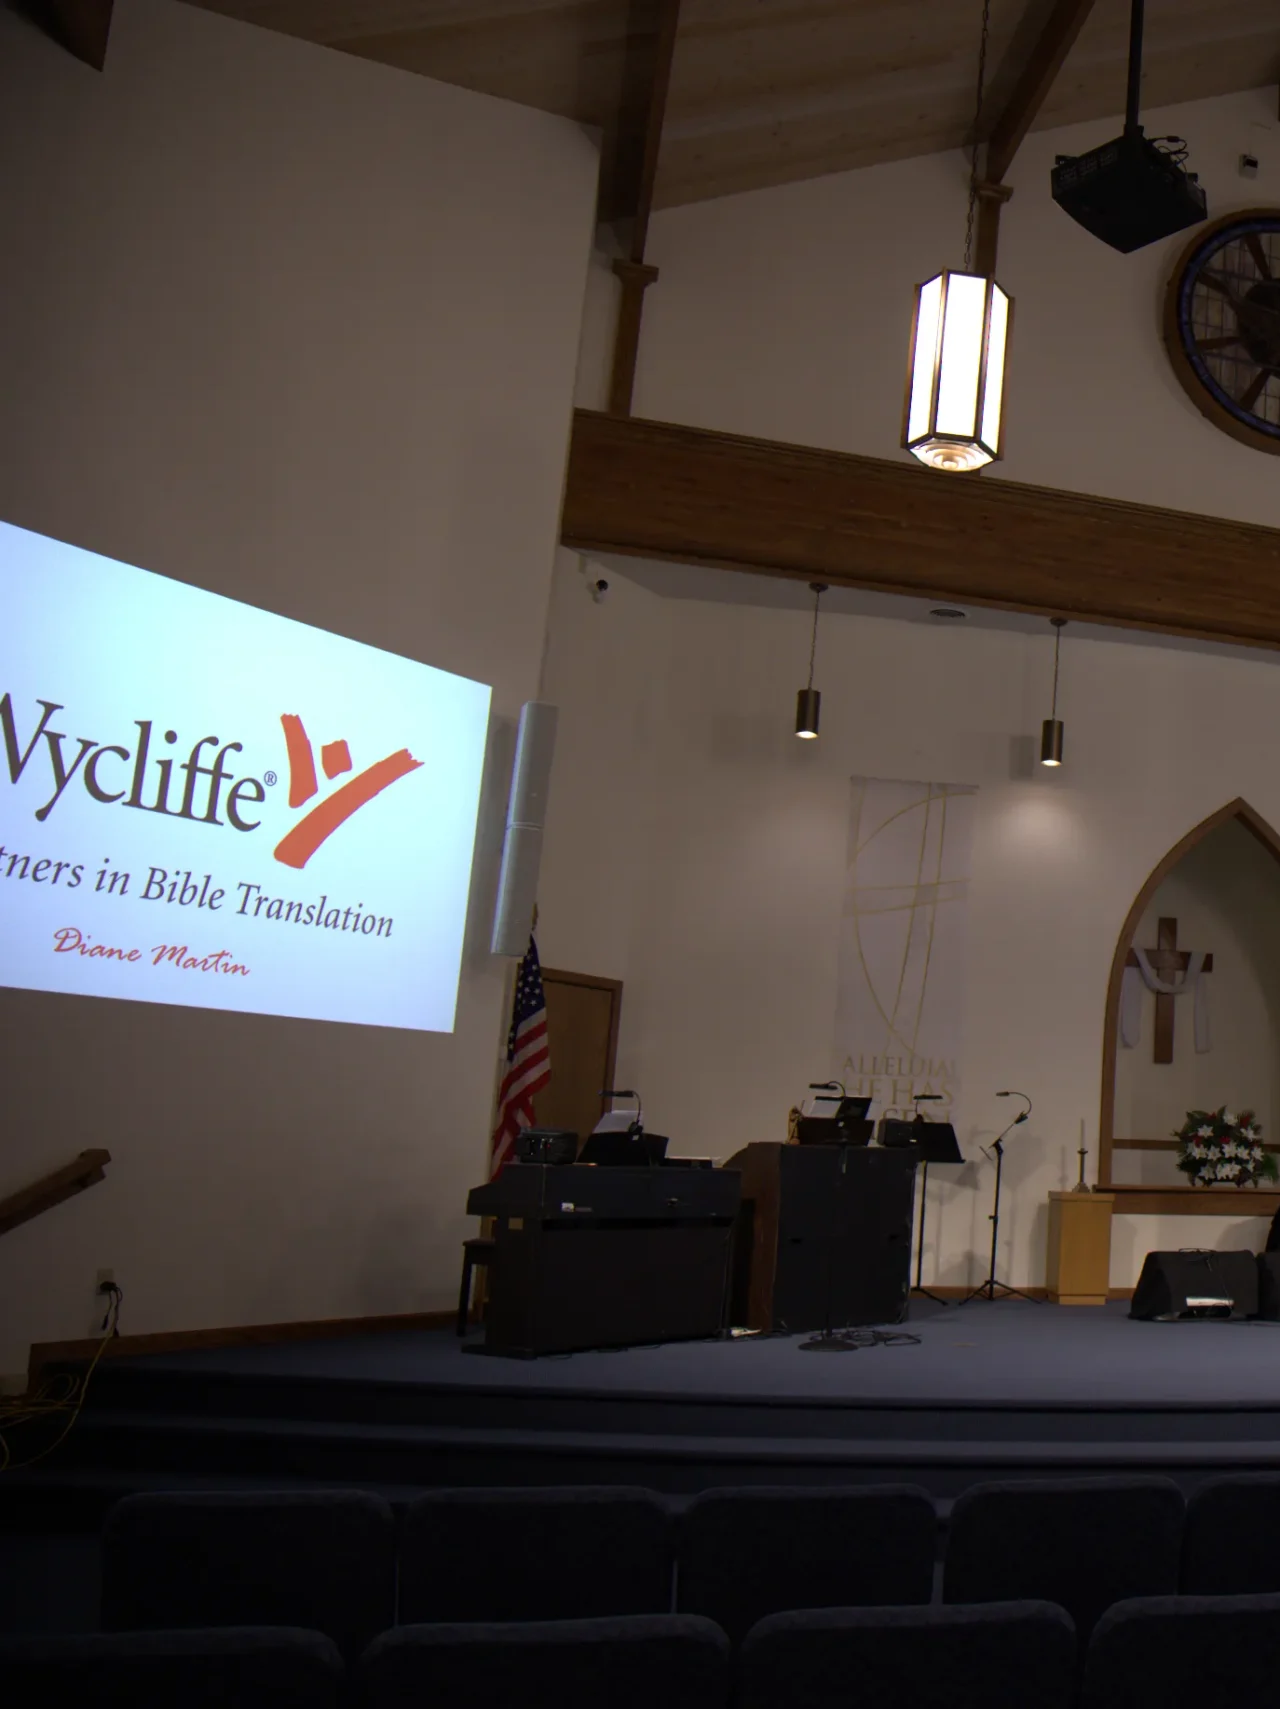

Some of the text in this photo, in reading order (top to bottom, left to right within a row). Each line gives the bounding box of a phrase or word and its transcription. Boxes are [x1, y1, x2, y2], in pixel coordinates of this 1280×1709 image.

[94, 858, 131, 897] in
[140, 867, 226, 911] Bible
[236, 882, 395, 938] Translation
[53, 927, 251, 976] Diane Martin
